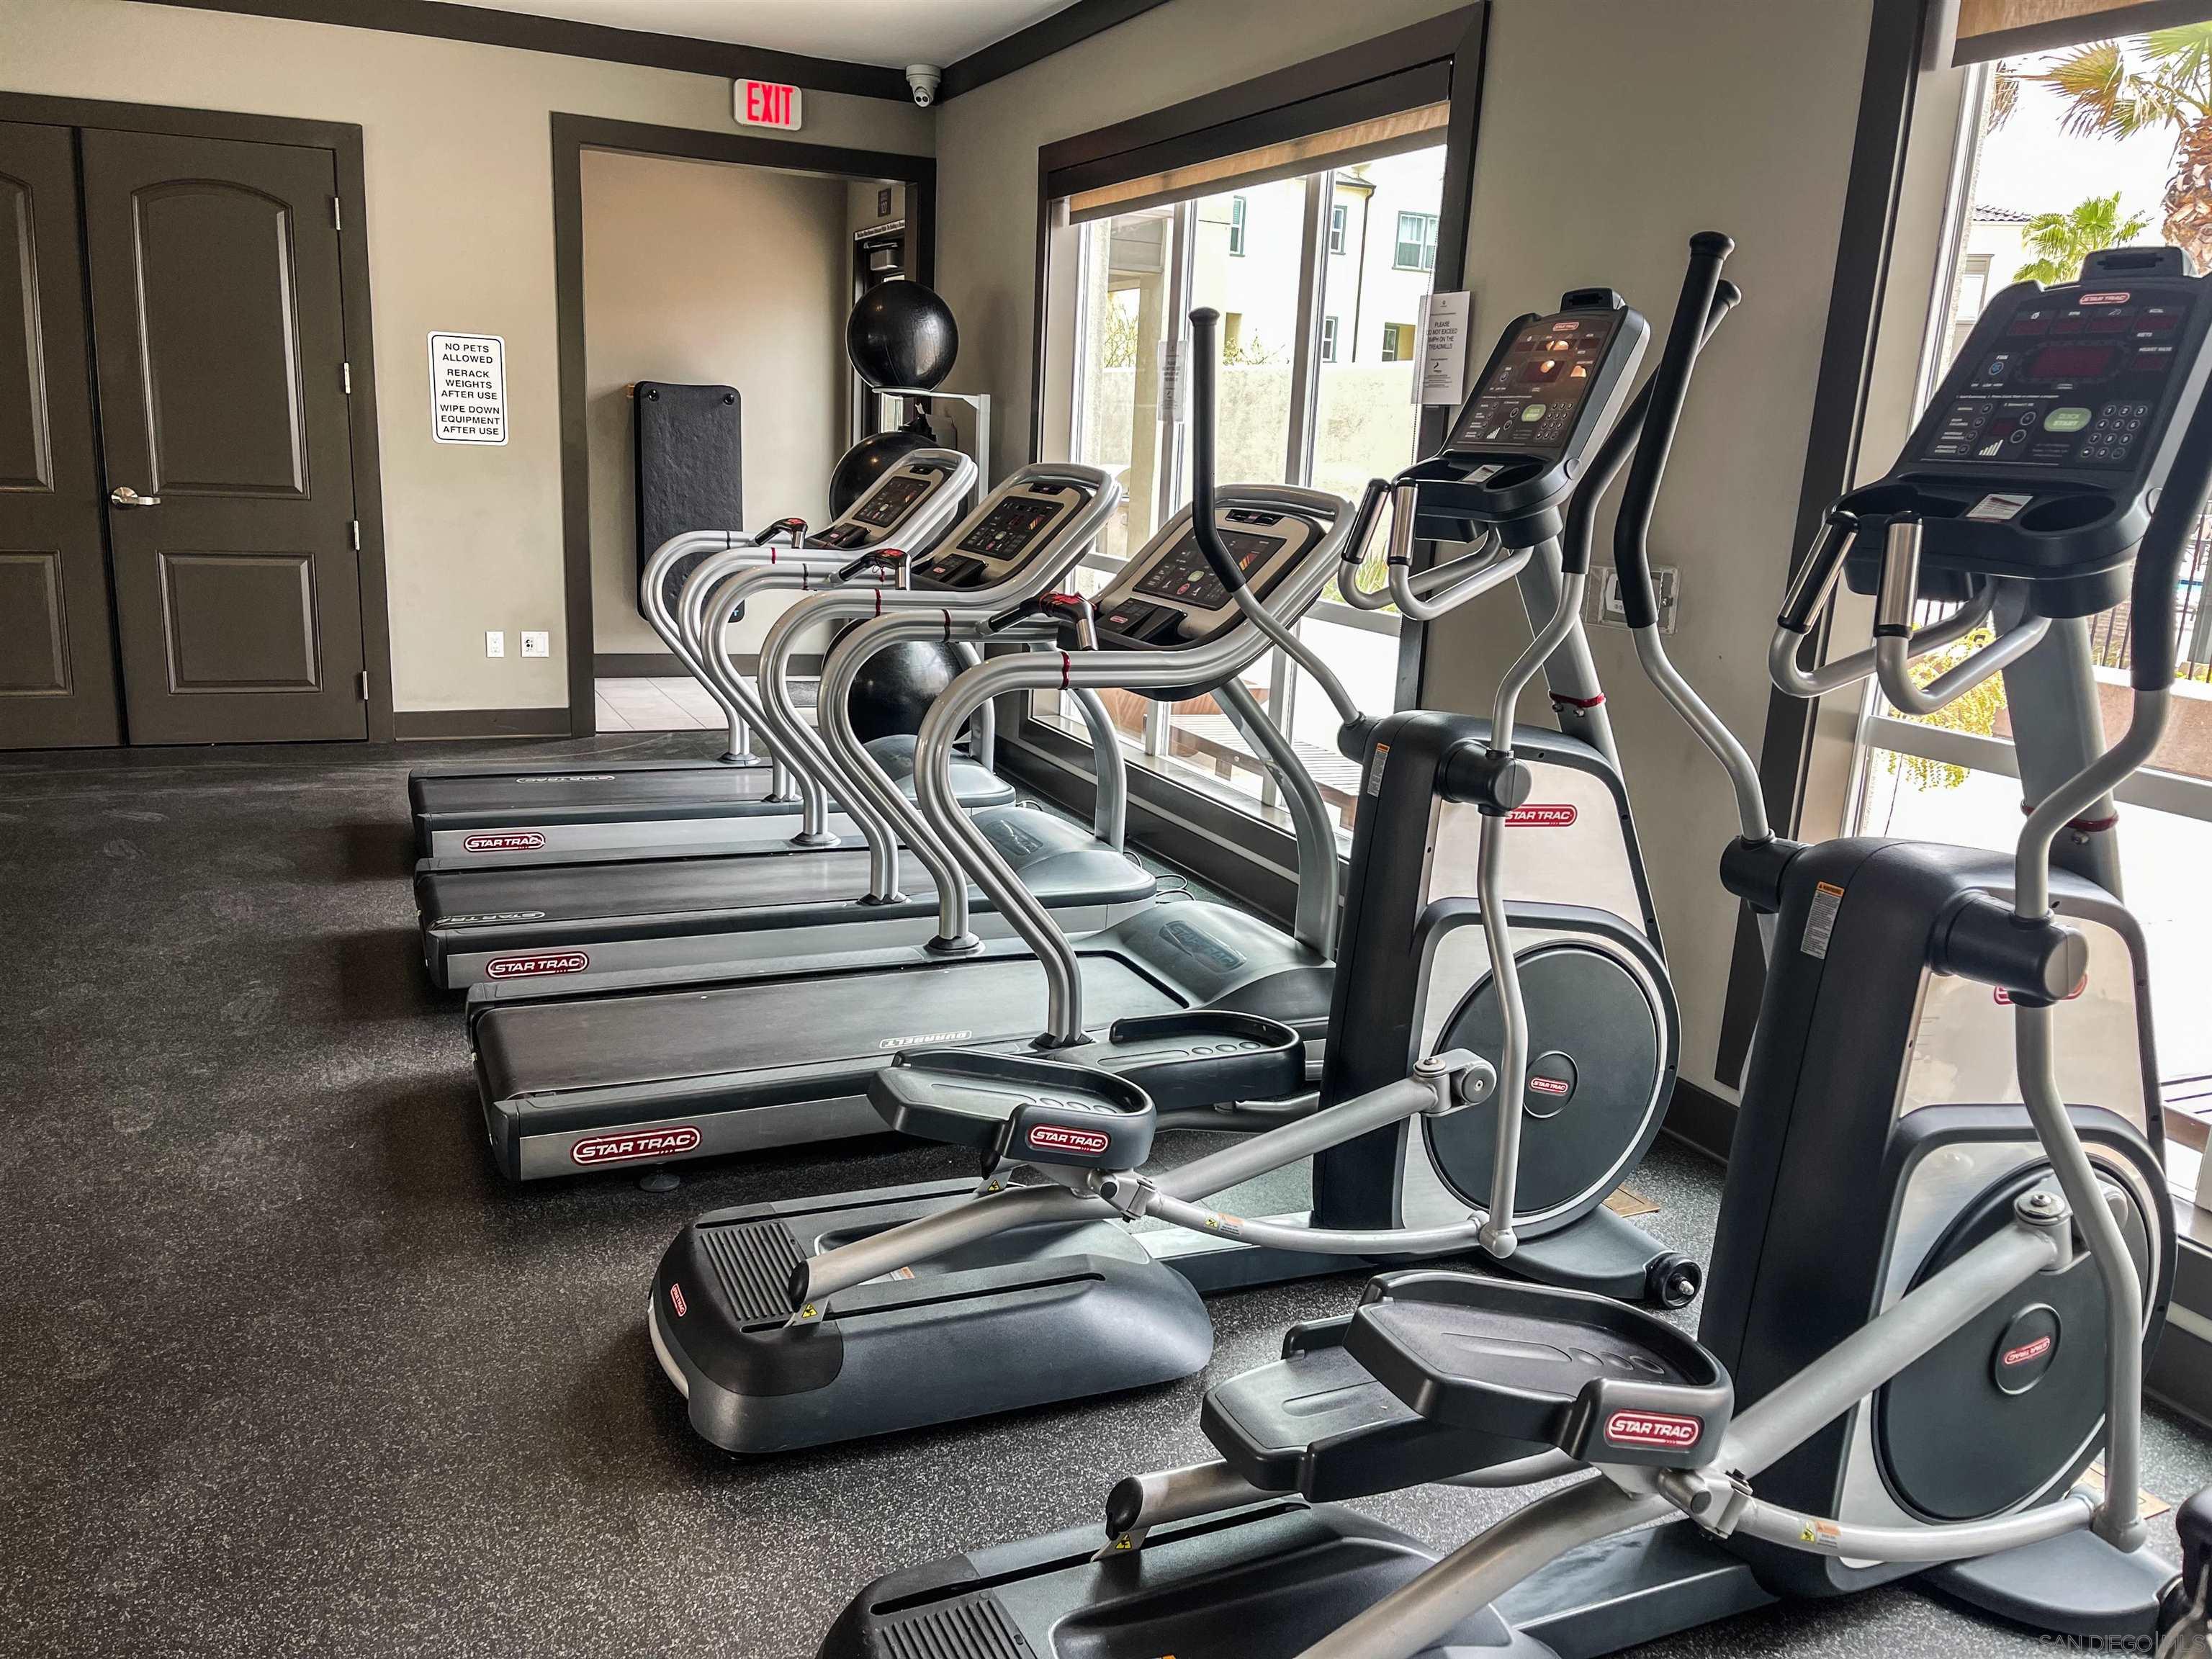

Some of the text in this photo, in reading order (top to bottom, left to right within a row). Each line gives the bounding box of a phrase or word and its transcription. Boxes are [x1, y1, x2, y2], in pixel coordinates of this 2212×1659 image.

[747, 81, 794, 125] EXIT
[463, 344, 490, 352] PETS
[442, 354, 493, 364] ALLOWED
[447, 369, 490, 378] RERACK
[445, 379, 492, 389] WEIGHTS
[441, 390, 497, 400] AFTER USE
[469, 406, 500, 414] DOWN
[441, 415, 500, 424] EQUIPMENT
[1506, 811, 1570, 820] STAR TRAC
[471, 837, 539, 847] STAR TRAC
[494, 958, 580, 972] STAR TRAC
[1036, 1131, 1103, 1147] STAR TRAC
[582, 1134, 691, 1157] STAR TRAC
[1615, 1420, 1692, 1438] STAR TRAC
